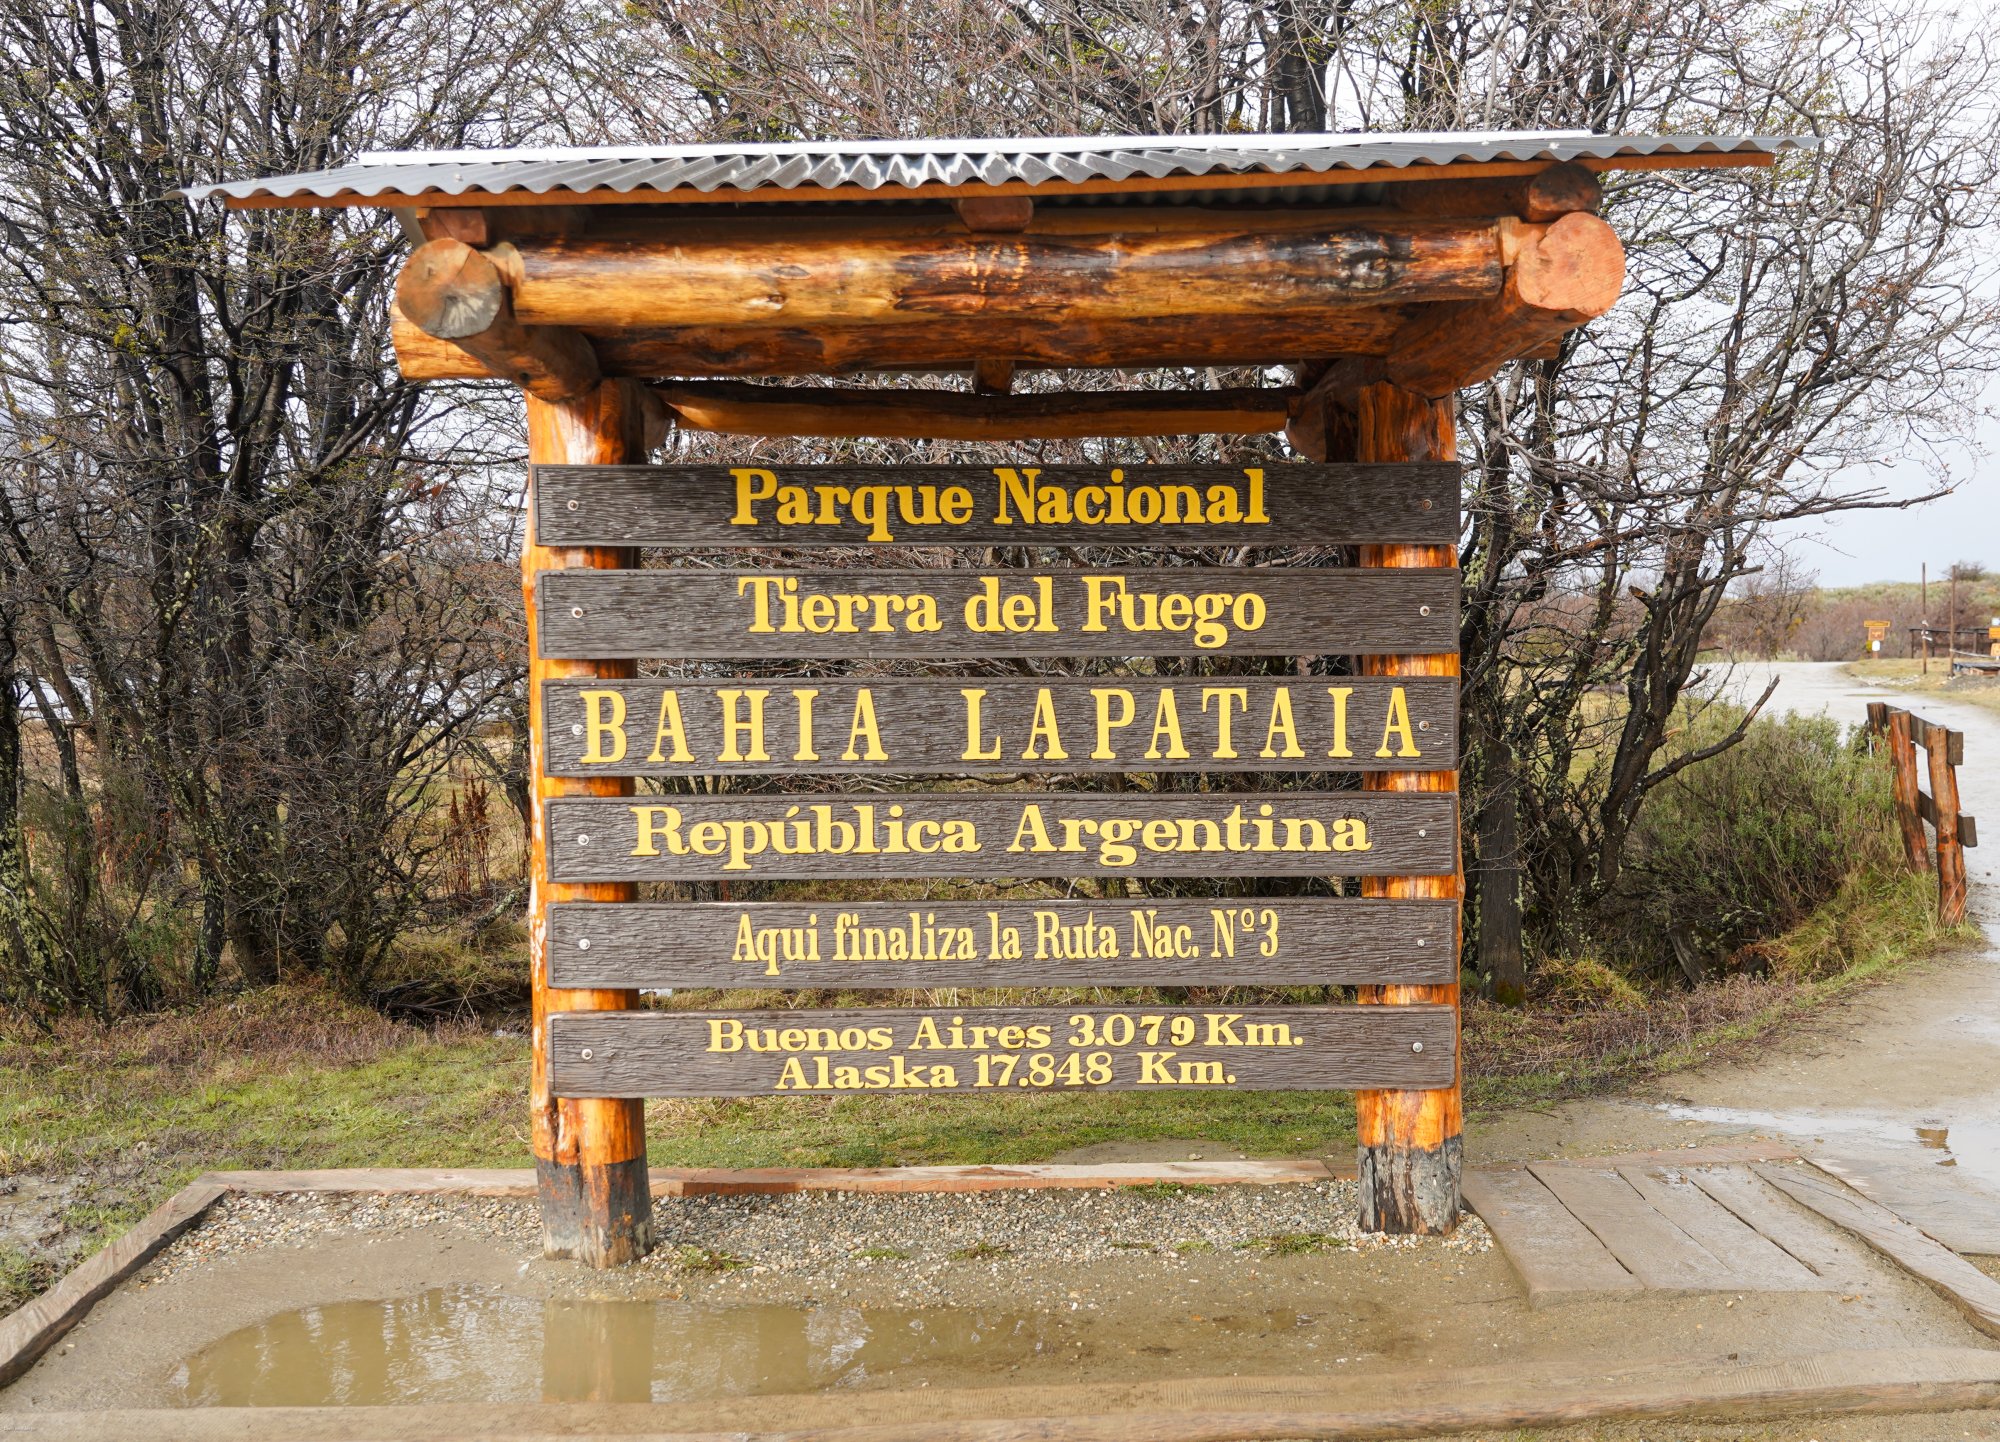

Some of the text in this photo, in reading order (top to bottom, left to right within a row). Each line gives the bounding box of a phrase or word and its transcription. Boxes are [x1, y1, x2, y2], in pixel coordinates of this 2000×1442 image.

[729, 468, 1270, 542] Parque Nacional
[737, 575, 1267, 649] Tierra del Fuego
[578, 686, 1423, 765] BAHIA LAPATAIA
[628, 803, 1373, 871] República Argentina
[731, 912, 822, 977] Aqui
[831, 911, 978, 962] finaliza
[987, 910, 1023, 961] la
[1033, 910, 1120, 961] Ruta
[1130, 908, 1200, 960] Nac.
[705, 1013, 1305, 1053] Buenos Aires 3.079 Km.
[773, 1051, 1238, 1091] Alaska 17.848 Km.
